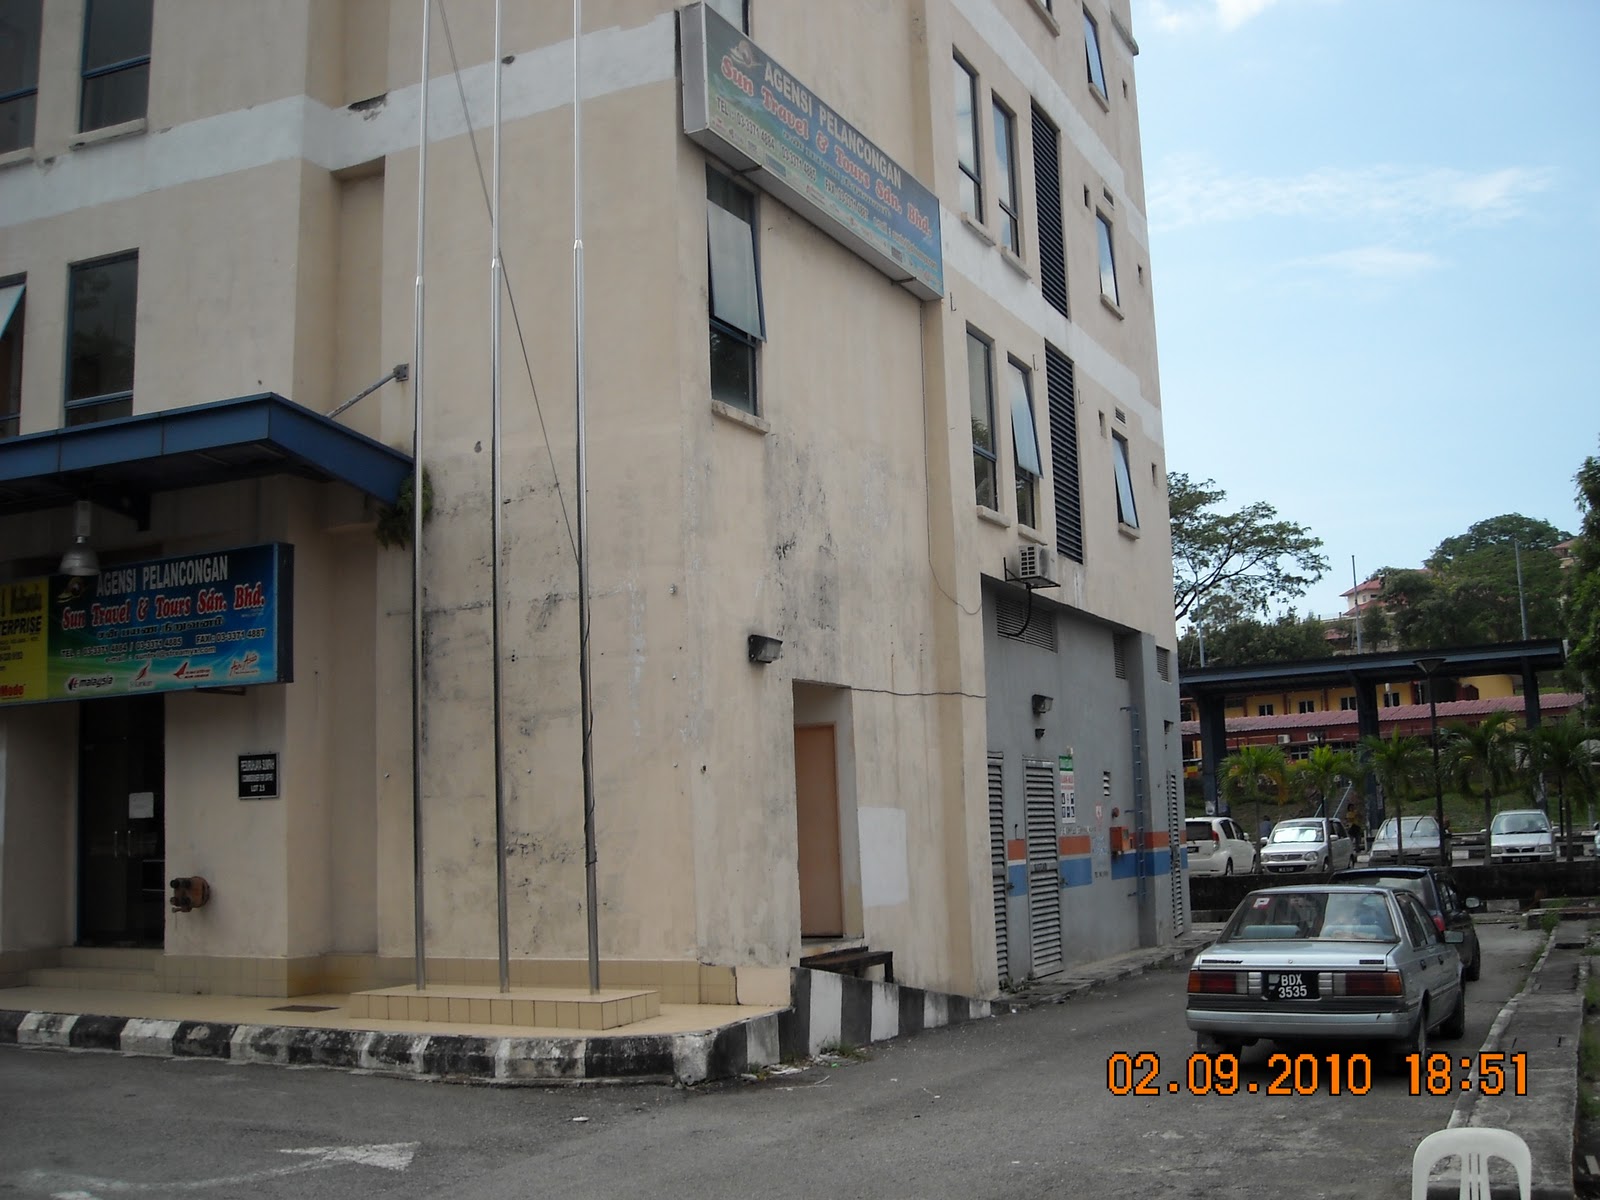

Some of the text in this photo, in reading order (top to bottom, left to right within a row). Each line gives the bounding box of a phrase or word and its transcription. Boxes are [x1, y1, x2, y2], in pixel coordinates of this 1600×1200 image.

[715, 97, 729, 118] TEL
[764, 61, 813, 118] AGENSI
[818, 105, 902, 190] PELANCONGAN
[720, 55, 754, 97] Sun
[761, 85, 809, 140] Travel
[816, 130, 829, 155] &
[835, 144, 870, 189] Tours
[875, 178, 903, 215] Sdn.
[907, 202, 933, 239] Bhd.
[96, 555, 228, 597] AGENSI PELANCONGAN
[62, 581, 265, 630] Sun Travel & Tours Sdn. Bhd.
[61, 648, 75, 659] TEL
[195, 633, 211, 644] FAX
[216, 631, 245, 643] 03-3371
[245, 628, 266, 639] 4887
[1278, 985, 1308, 998] 3535
[1281, 973, 1303, 986] BDX
